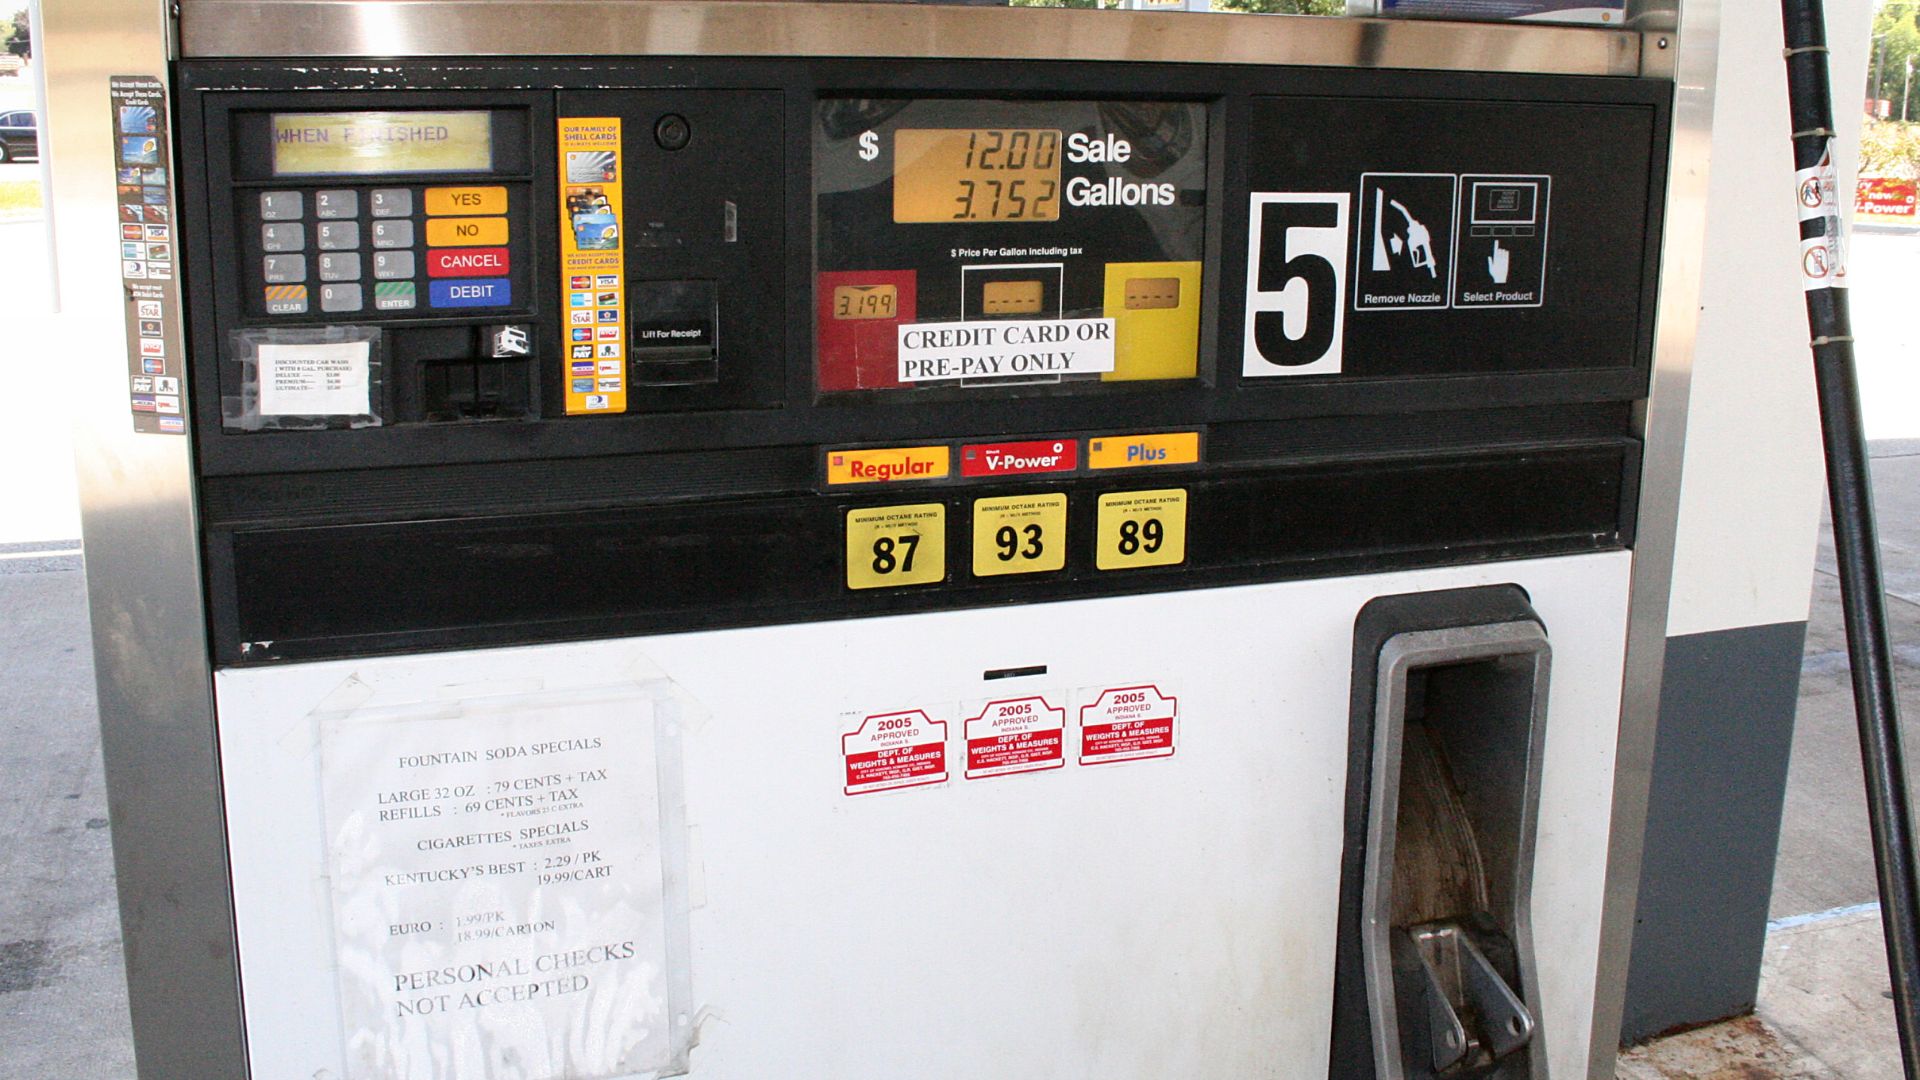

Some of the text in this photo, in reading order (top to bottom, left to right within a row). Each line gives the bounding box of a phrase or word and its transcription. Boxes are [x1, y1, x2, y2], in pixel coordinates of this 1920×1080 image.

[275, 128, 329, 144] WHEN
[858, 130, 879, 161] $
[964, 131, 1057, 170] 12.00
[1067, 133, 1131, 162] Sale
[451, 193, 481, 205] YES
[1066, 177, 1175, 207] Gallons
[265, 196, 272, 207] 1
[321, 195, 328, 206] 2
[375, 194, 383, 205] 3
[953, 180, 1056, 220] 3.752
[266, 227, 274, 238] 4
[322, 227, 330, 237] 5
[377, 225, 384, 236] 6
[456, 224, 479, 236] NO
[958, 248, 980, 258] Price
[982, 247, 998, 257] Per
[999, 247, 1027, 257] Gallon
[1029, 246, 1068, 258] including
[1069, 246, 1082, 255] tax
[268, 259, 276, 270] 7
[323, 258, 331, 269] 8
[378, 256, 385, 267] 9
[440, 254, 502, 268] CANCEL
[450, 285, 494, 298] DEBIT
[1254, 202, 1338, 367] 5
[325, 289, 333, 300] 0
[1364, 291, 1441, 304] Remove Nozzle
[1463, 291, 1533, 302] Select Product
[272, 303, 302, 312] CLEAR
[382, 299, 410, 308] ENTER
[838, 294, 892, 316] 3.199
[642, 329, 702, 338] Lift For Receipt
[903, 322, 1110, 350] CREDIT CARD OR
[904, 352, 1075, 378] PRE-PAY ONLY
[1127, 444, 1166, 462] Plus
[985, 454, 1059, 471] V-Power
[850, 458, 934, 482] Regular
[855, 515, 884, 523] MINIMUM
[996, 524, 1043, 562] 93
[1118, 518, 1163, 556] 89
[872, 534, 922, 575] 87
[1114, 692, 1145, 704] 2005
[999, 704, 1032, 717] 2005
[1106, 703, 1152, 715] APPROVED
[877, 717, 912, 731] 2005
[992, 715, 1039, 728] APPROVED
[1112, 721, 1145, 731] DEPT. OF
[870, 728, 919, 742] APPROVED
[998, 733, 1033, 743] DEPT. OF
[1086, 731, 1120, 741] WEIGHTS
[1129, 726, 1170, 736] MEASURES
[399, 737, 602, 769] FOUNTAIN SODA SPECIALS
[877, 746, 913, 758] DEPT. OF
[971, 743, 1007, 755] WEIGHTS
[1016, 737, 1059, 749] MEASURES
[850, 758, 887, 770] WEIGHTS
[896, 751, 942, 763] MEASURES
[378, 788, 432, 805] LARGE
[434, 786, 452, 799] 32
[454, 783, 475, 798] OZ
[494, 780, 511, 794] 79
[513, 774, 563, 793] CENTS
[565, 773, 575, 783] +
[577, 768, 608, 784] TAX
[379, 804, 442, 822] REFILLS
[465, 801, 481, 815] 69
[485, 793, 534, 812] CENTS
[537, 793, 547, 803] +
[549, 788, 579, 803] TAX
[558, 801, 585, 813] EXTRA
[417, 819, 589, 852] CIGARETTES SPECIALS
[545, 836, 571, 847] EXTRA
[384, 863, 485, 887] KENTUCKY'S
[487, 860, 526, 876] BEST
[545, 854, 572, 870] 2.29
[582, 850, 602, 864] PK
[537, 864, 613, 886] 19.99/CART
[389, 920, 432, 937] EURO
[393, 941, 636, 992] PERSONAL CHECKS
[396, 974, 590, 1017] NOT ACCEPTED
